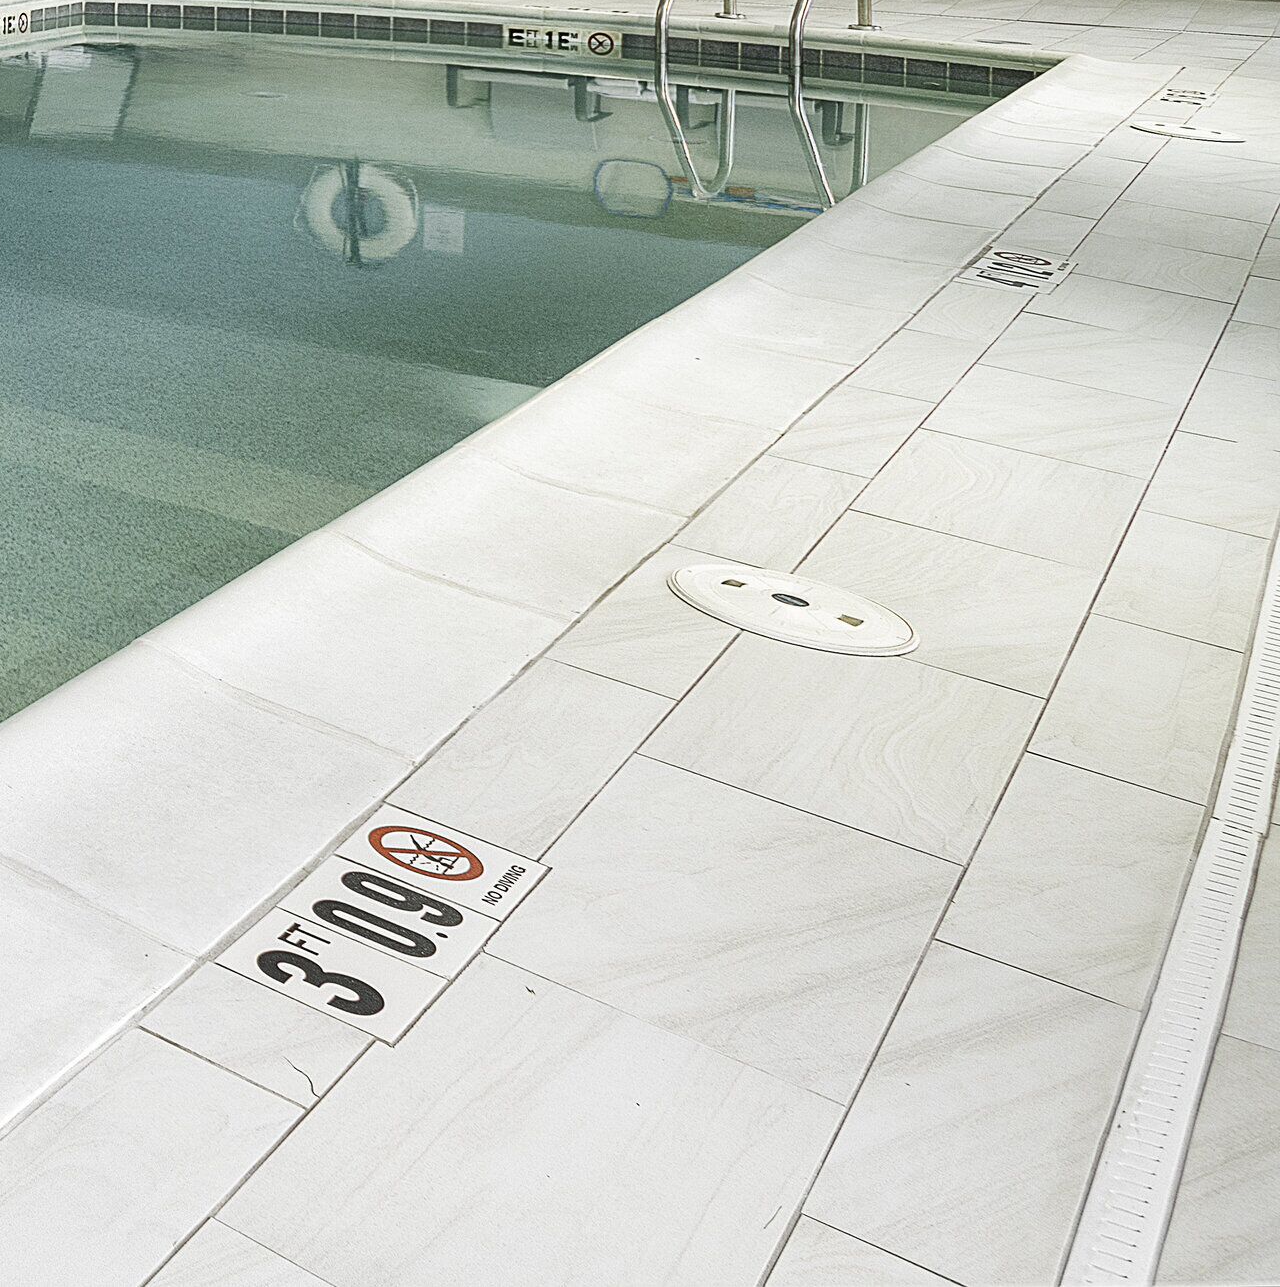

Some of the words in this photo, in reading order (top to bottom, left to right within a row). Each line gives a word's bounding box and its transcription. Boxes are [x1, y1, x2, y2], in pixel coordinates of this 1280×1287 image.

[481, 890, 503, 906] NO
[493, 865, 527, 893] DIVING
[256, 949, 385, 1016] 3
